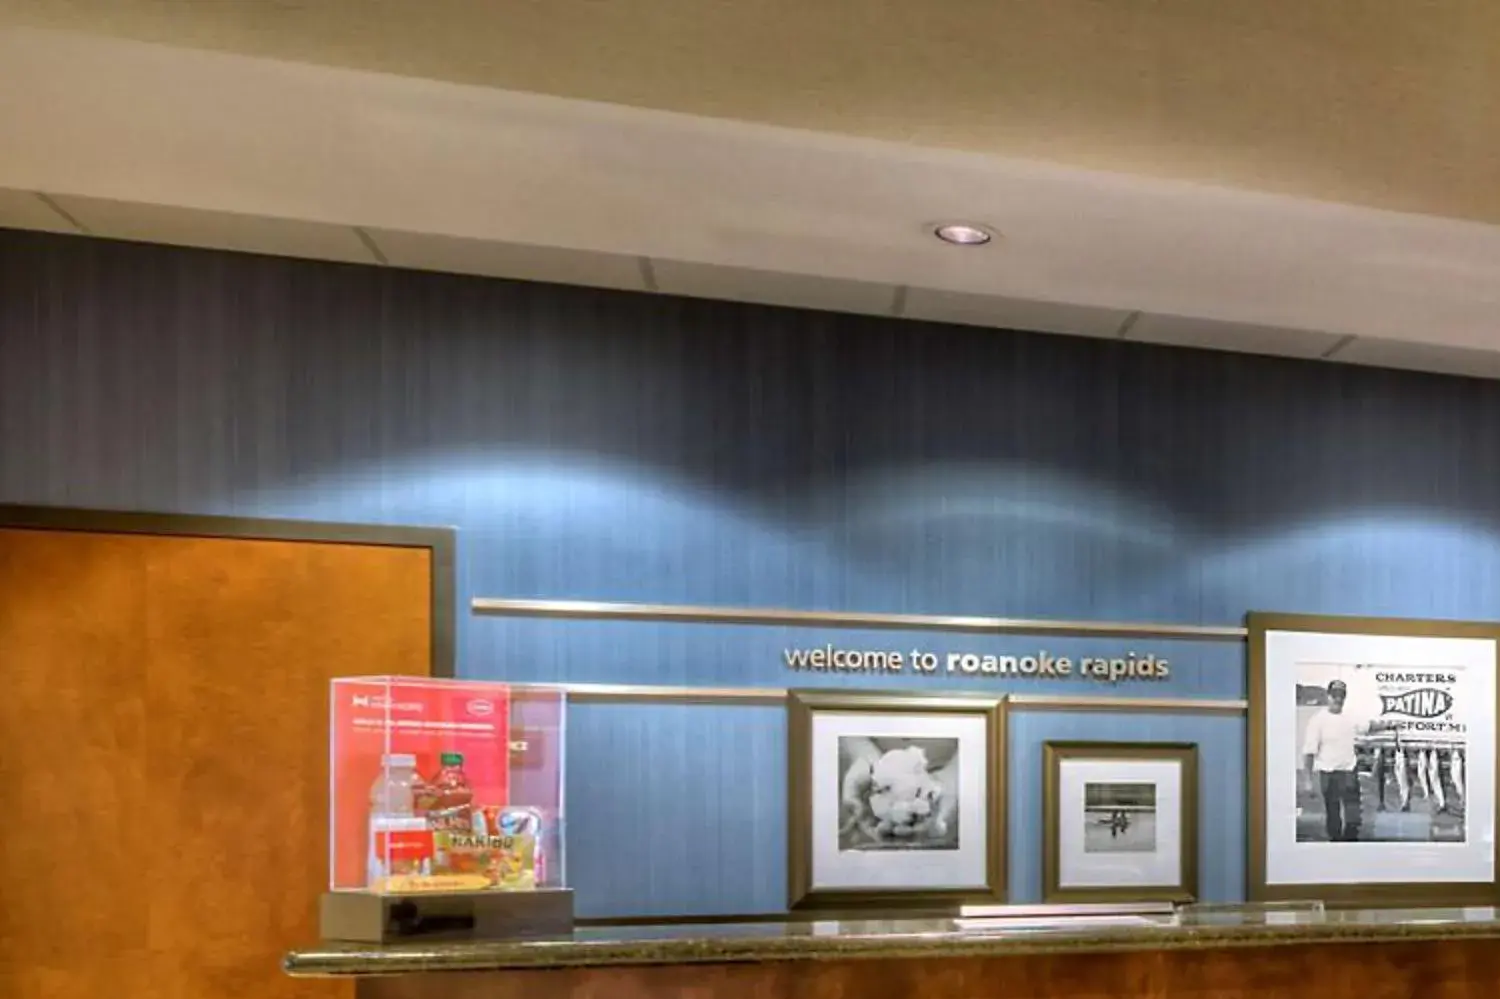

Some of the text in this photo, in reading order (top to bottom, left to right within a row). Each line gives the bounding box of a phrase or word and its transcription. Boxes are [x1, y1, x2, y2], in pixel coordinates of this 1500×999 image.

[784, 644, 1170, 681] welcome to roanoke rapids
[1375, 672, 1457, 683] CHARTERS
[1386, 690, 1446, 716] PATINA
